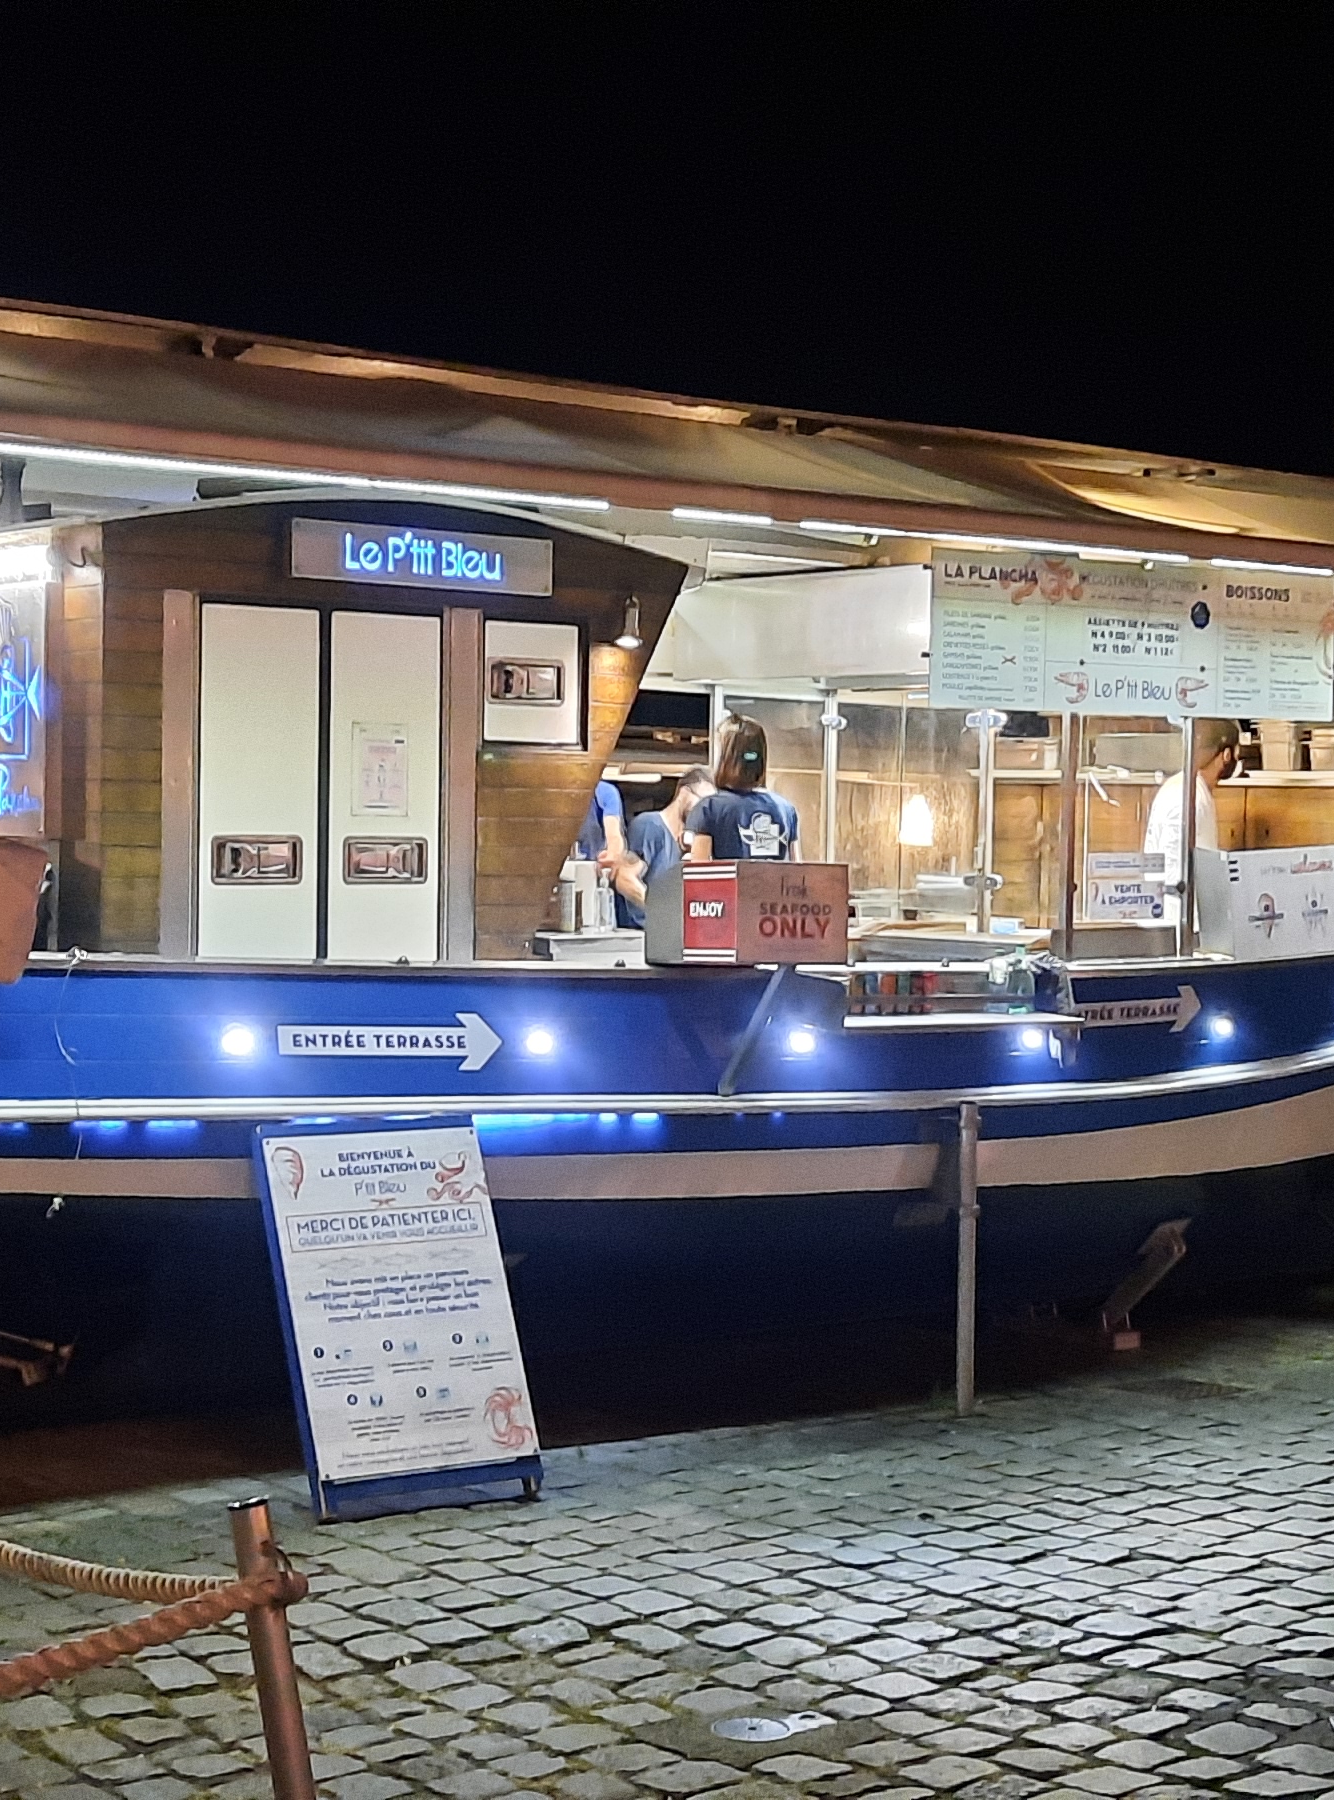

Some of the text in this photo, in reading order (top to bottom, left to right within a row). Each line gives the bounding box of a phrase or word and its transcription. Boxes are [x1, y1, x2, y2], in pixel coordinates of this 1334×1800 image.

[344, 530, 503, 581] Le P'tit Bleu
[944, 563, 1039, 586] LA PLANCHA
[1225, 584, 1291, 603] BOISSONS
[1094, 675, 1172, 701] Le P'tit Bleu
[1114, 883, 1142, 894] VENTE
[689, 901, 724, 917] ENJOY
[758, 902, 832, 916] SEAFOOD
[758, 916, 831, 939] ONLY
[1120, 1003, 1180, 1018] TERRASSE
[292, 1030, 467, 1050] ENTRÉE TERRASSE
[338, 1146, 415, 1162] BIENVENUE À
[320, 1161, 437, 1178] LA DÉGUSTATION DU
[378, 1180, 407, 1194] Bleu
[297, 1217, 345, 1234] MERCI
[349, 1216, 369, 1230] DE
[370, 1210, 449, 1229] PATIENTER
